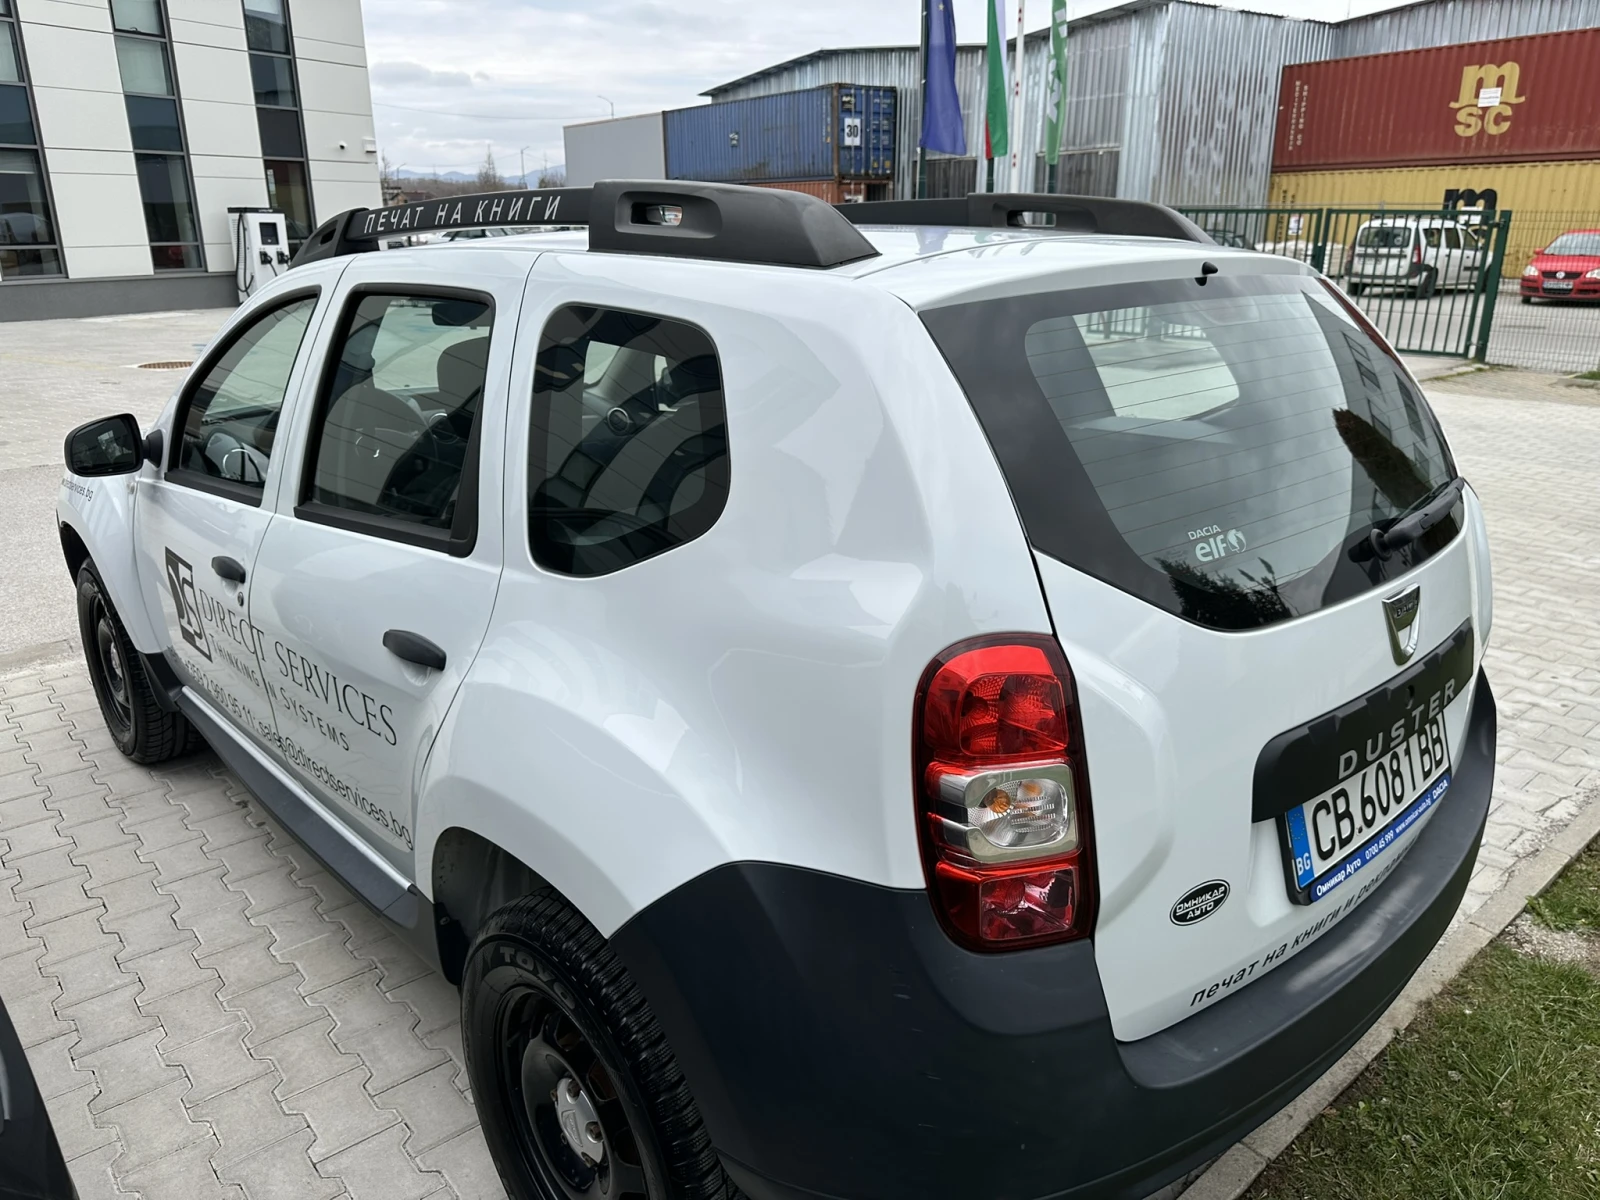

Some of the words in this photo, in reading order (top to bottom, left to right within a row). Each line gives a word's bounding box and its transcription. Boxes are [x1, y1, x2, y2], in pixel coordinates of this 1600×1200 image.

[846, 124, 859, 138] 30
[364, 206, 424, 234] ПЕЧАТ
[434, 202, 462, 226] НА
[474, 195, 561, 223] КНИГИ
[1187, 524, 1222, 541] DACIA
[1195, 534, 1227, 562] elf
[199, 588, 267, 662] DIRECT
[274, 641, 398, 747] SERVICES
[208, 633, 260, 688] THINKING
[279, 687, 350, 752] SYSTEMS
[1338, 678, 1456, 781] DUSTER
[258, 721, 414, 852] sales@directservices.bg
[1295, 852, 1311, 876] BG
[1316, 868, 1346, 897] Омникар
[1346, 857, 1362, 876] Ауто
[1365, 843, 1379, 860] 0700
[1379, 837, 1386, 849] 45
[1385, 829, 1394, 844] 999
[1432, 779, 1448, 800] DACIA
[1176, 885, 1226, 913] ОМНИКАР
[1186, 901, 1215, 920] АУТО
[1190, 960, 1260, 1007] печат
[1262, 942, 1288, 968] на
[1291, 905, 1342, 949] книги
[1343, 893, 1356, 912] и
[500, 945, 576, 1010] TOYO
